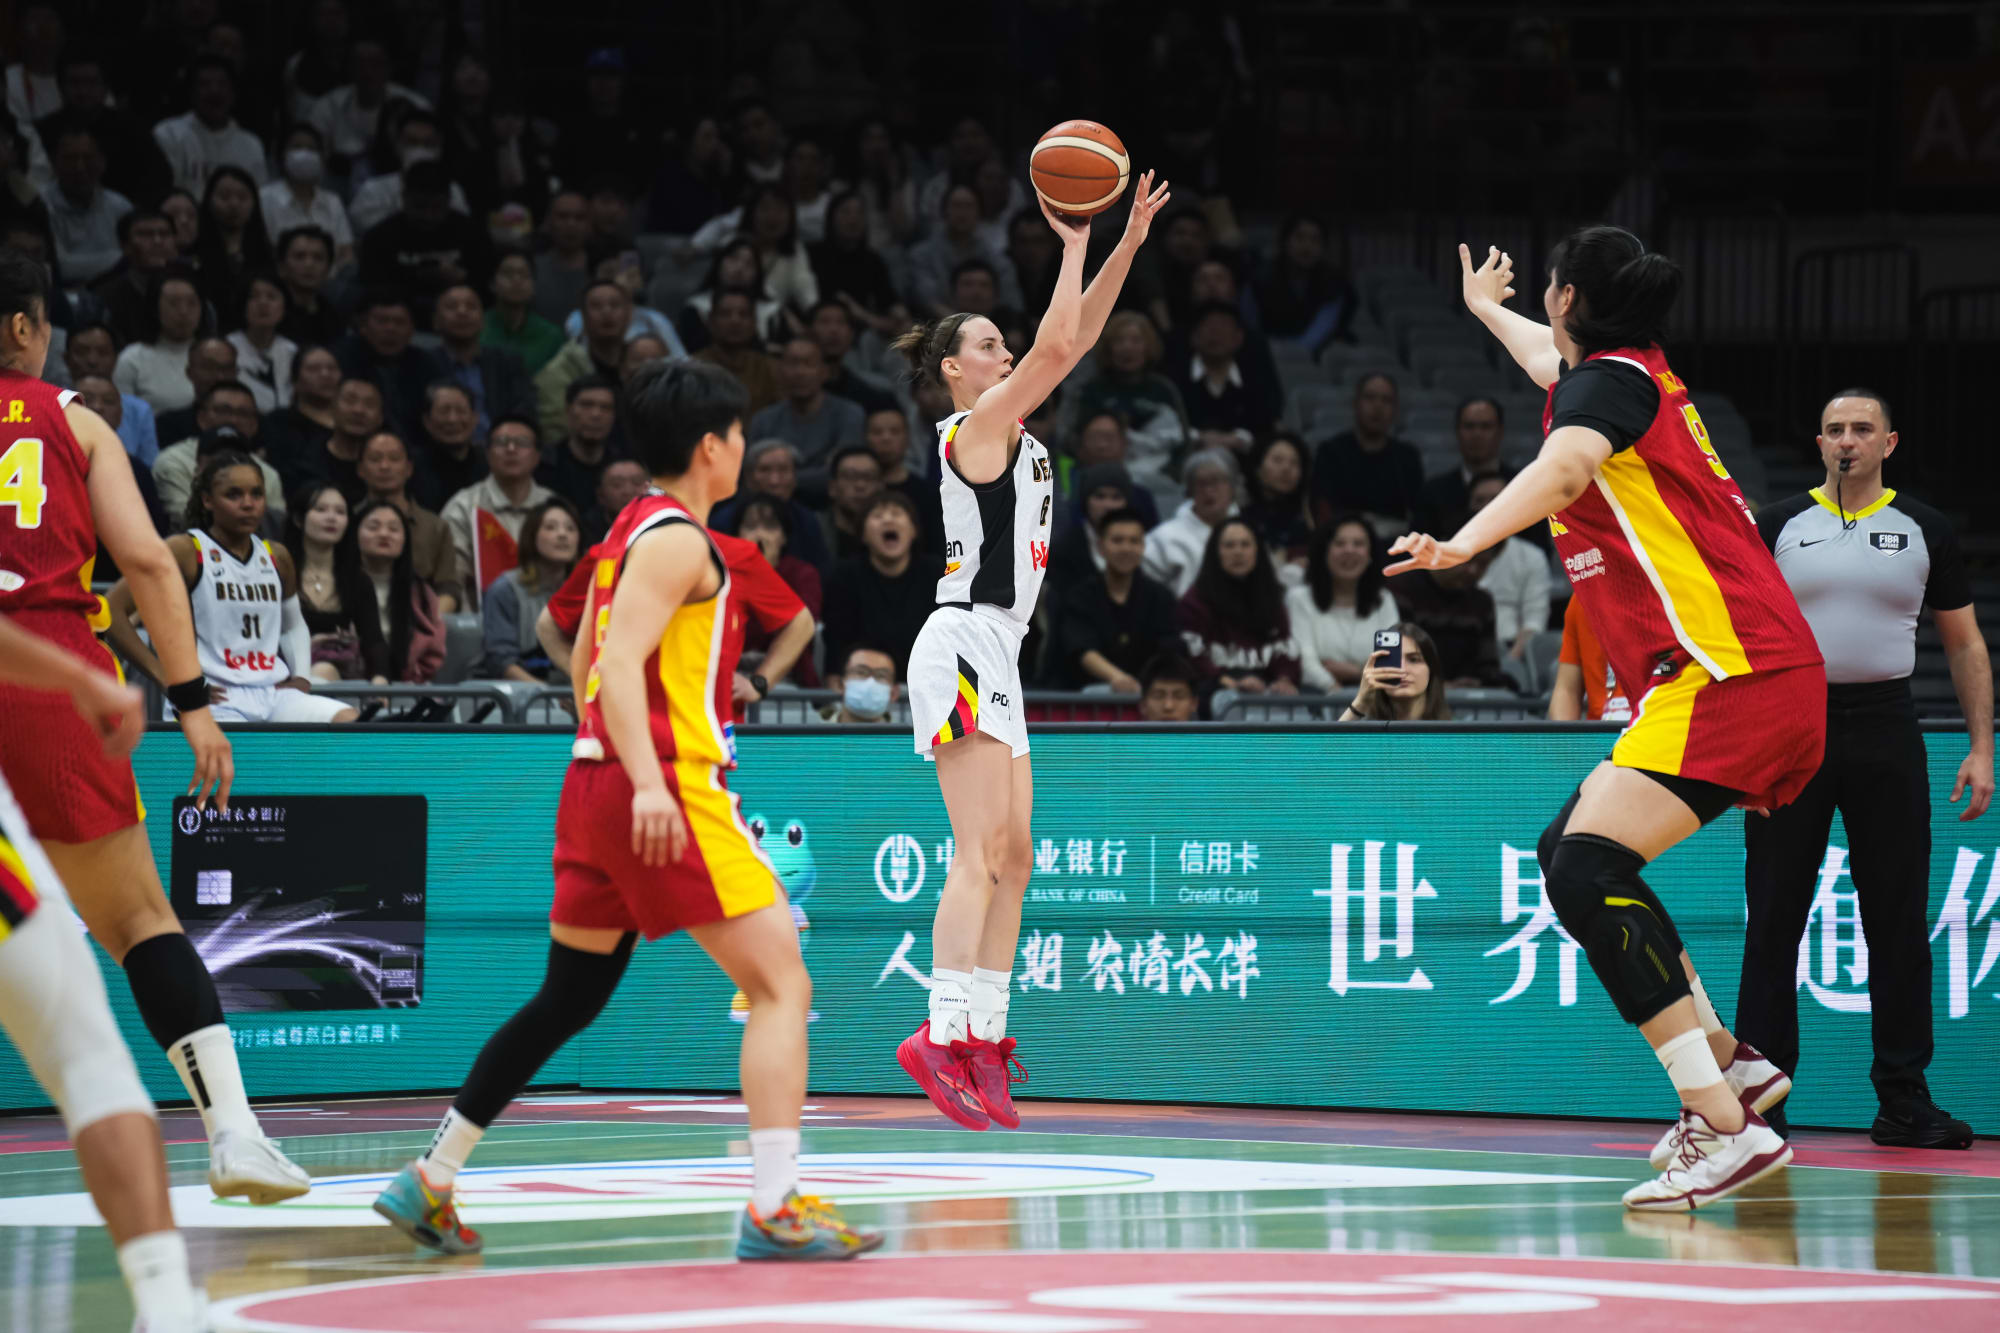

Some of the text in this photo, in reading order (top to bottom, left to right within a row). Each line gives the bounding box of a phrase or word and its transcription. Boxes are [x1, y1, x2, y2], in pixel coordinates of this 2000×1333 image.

[0, 438, 47, 528] 4
[1879, 534, 1899, 544] FIBA
[216, 581, 278, 602] BELGIUM
[241, 612, 261, 639] 31
[1179, 840, 1260, 875] 信用卡
[1031, 888, 1065, 902] BANK
[1068, 888, 1085, 901] OF
[1088, 888, 1127, 902] CHINA
[1178, 886, 1259, 904] Credit Card
